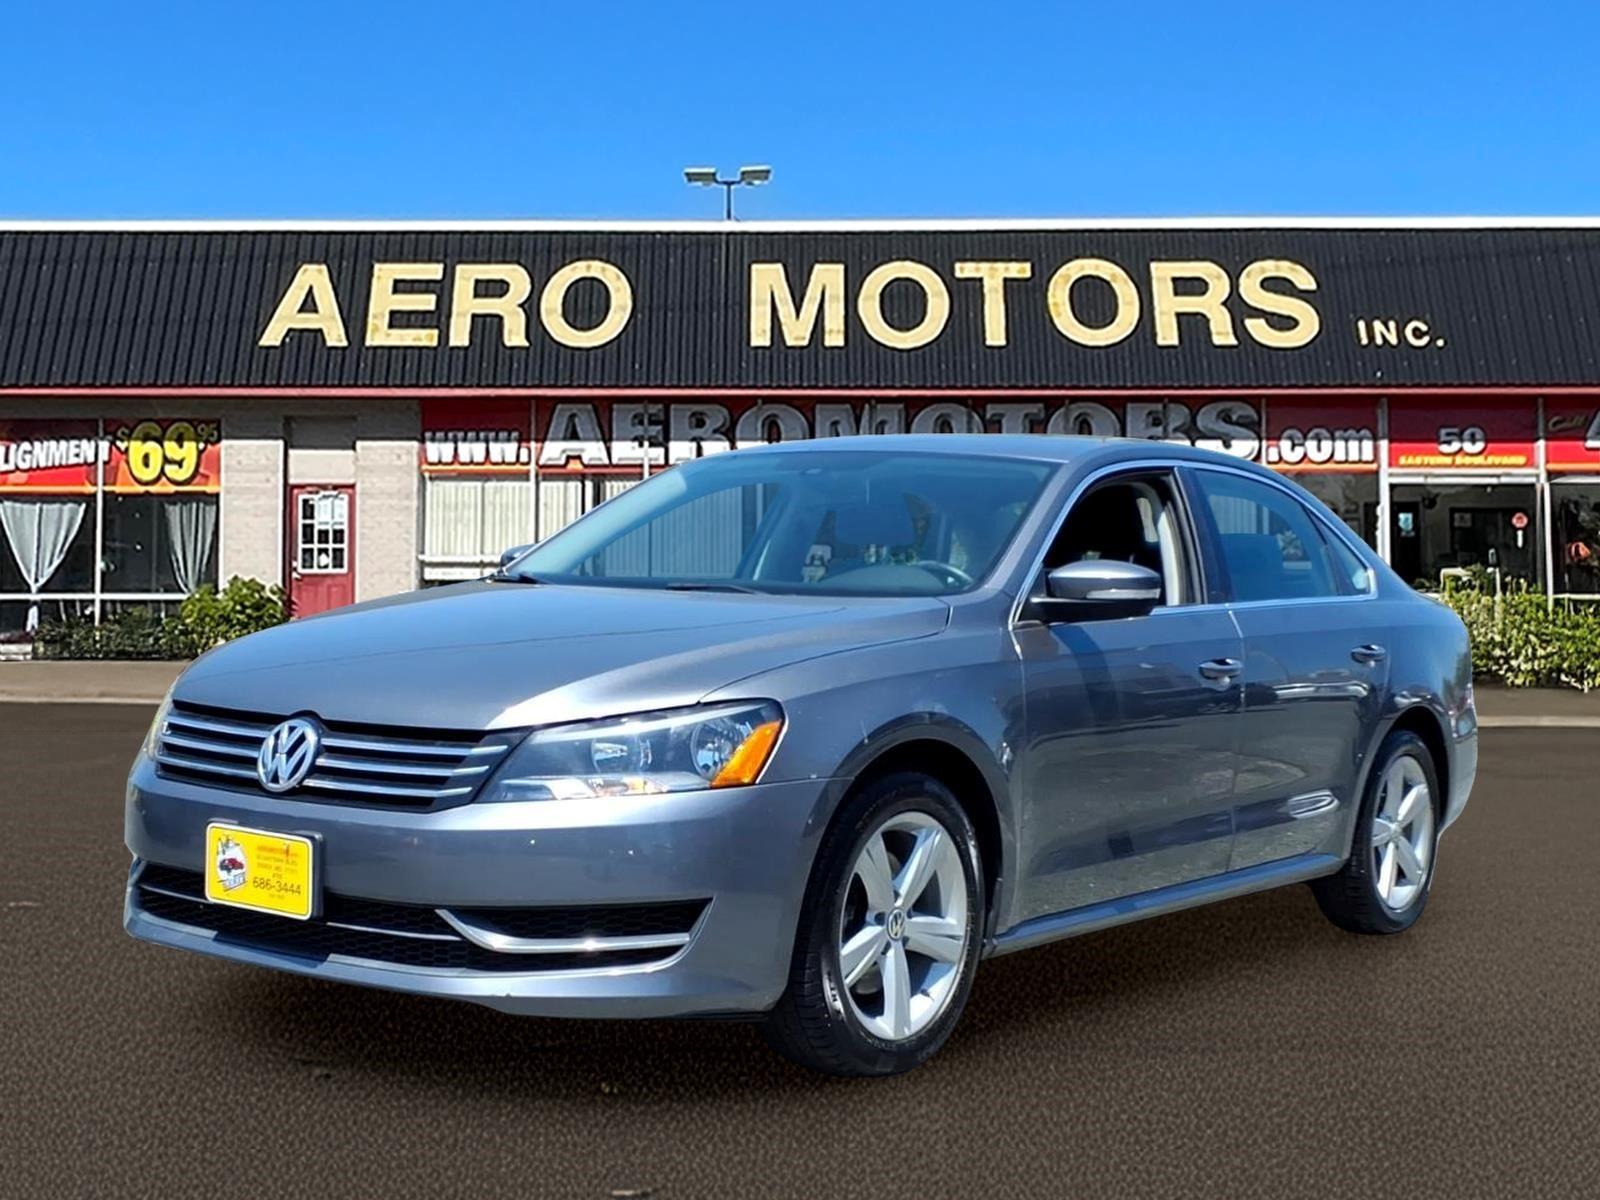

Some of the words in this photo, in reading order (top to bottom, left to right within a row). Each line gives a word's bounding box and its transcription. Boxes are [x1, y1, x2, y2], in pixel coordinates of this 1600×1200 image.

[258, 259, 633, 348] AERO
[750, 258, 1320, 349] MOTORS
[1357, 319, 1446, 347] INC.
[1438, 427, 1485, 454] 50
[252, 876, 302, 895] 686-3444
